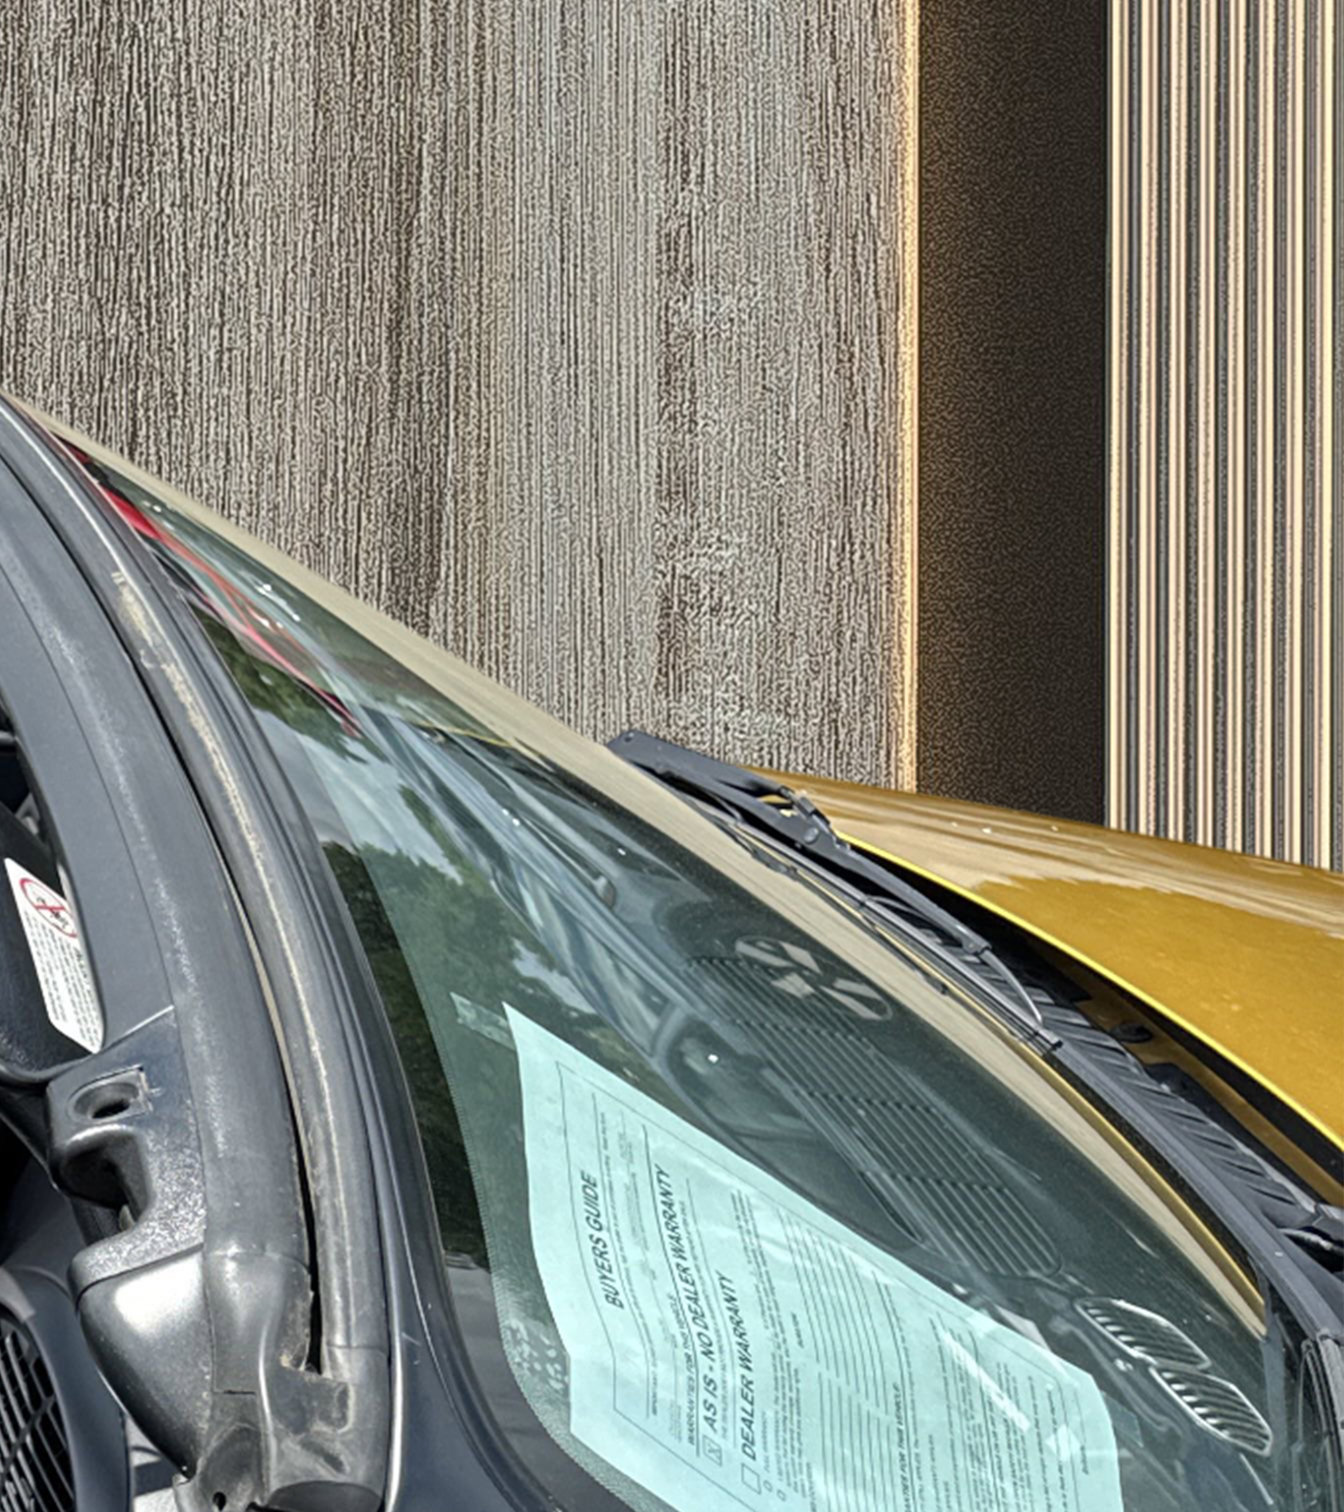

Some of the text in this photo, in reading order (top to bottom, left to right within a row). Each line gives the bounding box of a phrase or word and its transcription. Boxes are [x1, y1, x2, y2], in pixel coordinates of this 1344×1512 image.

[581, 1170, 602, 1232] GUIDE
[654, 1164, 688, 1260] WARRANTY
[588, 1234, 624, 1310] BUYERS
[676, 1262, 709, 1330] DEALER
[696, 1332, 715, 1362] NO
[715, 1270, 756, 1461] DEALER WARRANTY
[703, 1374, 717, 1398] IS
[703, 1399, 717, 1434] AS
